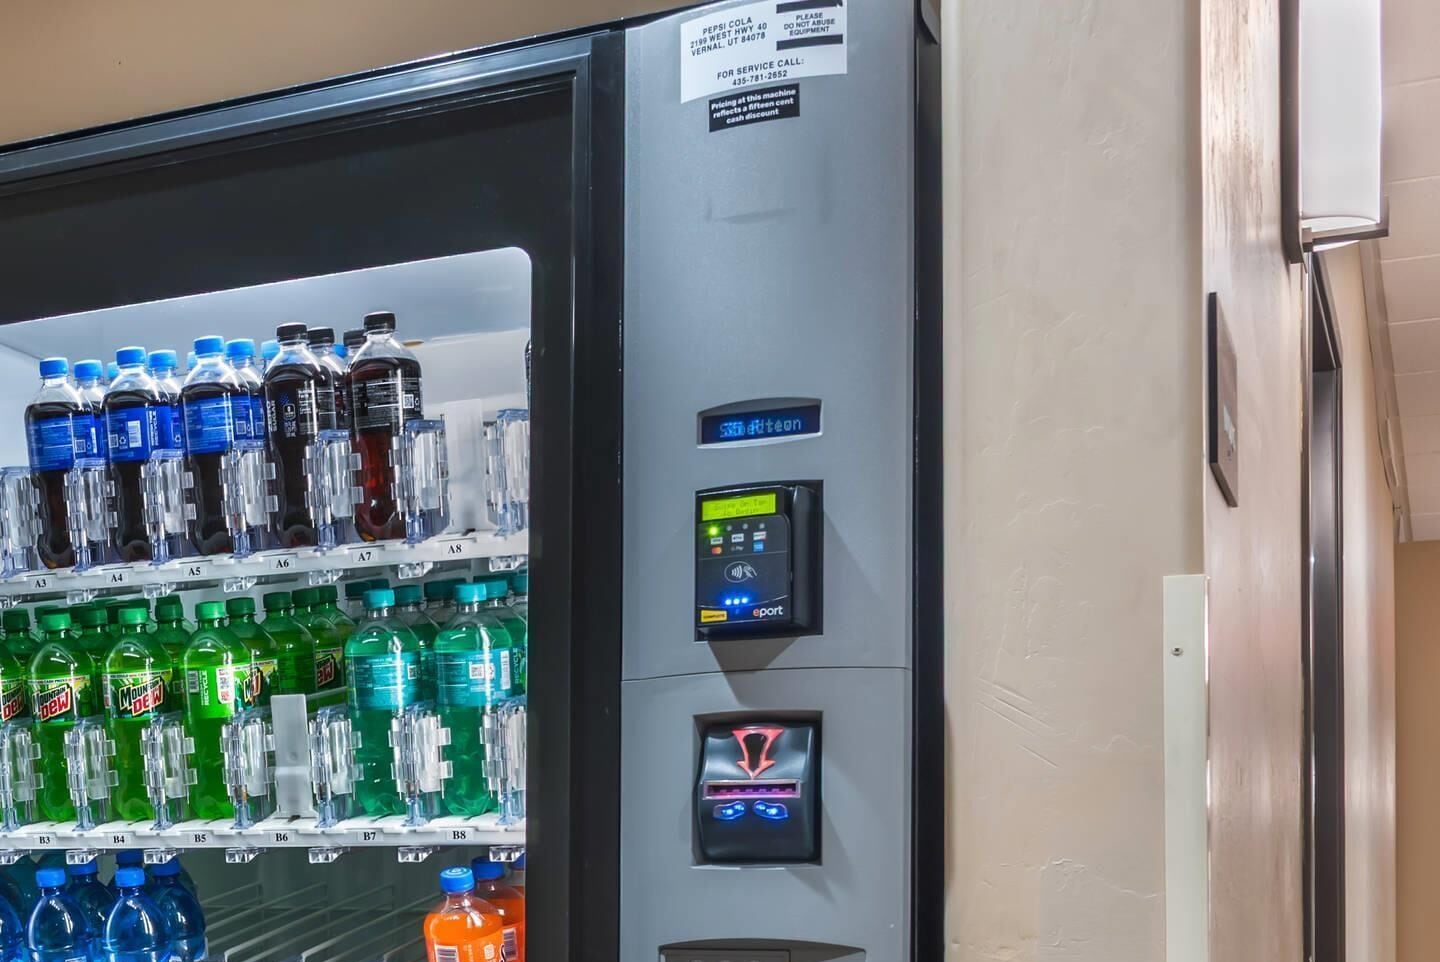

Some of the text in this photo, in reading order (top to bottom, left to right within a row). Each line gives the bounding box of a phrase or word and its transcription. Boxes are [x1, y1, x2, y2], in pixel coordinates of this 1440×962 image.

[796, 12, 823, 20] PLEASE
[703, 16, 752, 35] PEPSI COLA
[796, 20, 810, 28] NOT
[812, 18, 835, 26] ABUSE
[690, 22, 768, 48] 2199 WEST HWY 40
[790, 26, 829, 36] EQUIPMENT
[728, 37, 738, 46] UT
[741, 32, 766, 43] 84078
[717, 70, 734, 80] FOR
[736, 60, 774, 75] SERVICE
[712, 100, 736, 110] Pricing
[747, 94, 761, 102] this
[762, 89, 796, 99] machine
[713, 107, 742, 118] reflects
[748, 101, 774, 110] fifteen
[776, 98, 794, 106] cent
[726, 108, 779, 124] cash discount
[448, 544, 462, 554] A8
[358, 551, 372, 562] A7
[276, 558, 289, 568] A6
[188, 566, 200, 576] A5
[111, 573, 122, 582] A4
[35, 578, 46, 588] A3
[752, 606, 784, 618] eport
[40, 836, 50, 844] B3
[114, 835, 124, 844] B4
[194, 834, 206, 843] B5
[276, 832, 288, 842] B6
[364, 832, 376, 841] B7
[453, 830, 466, 840] B8
